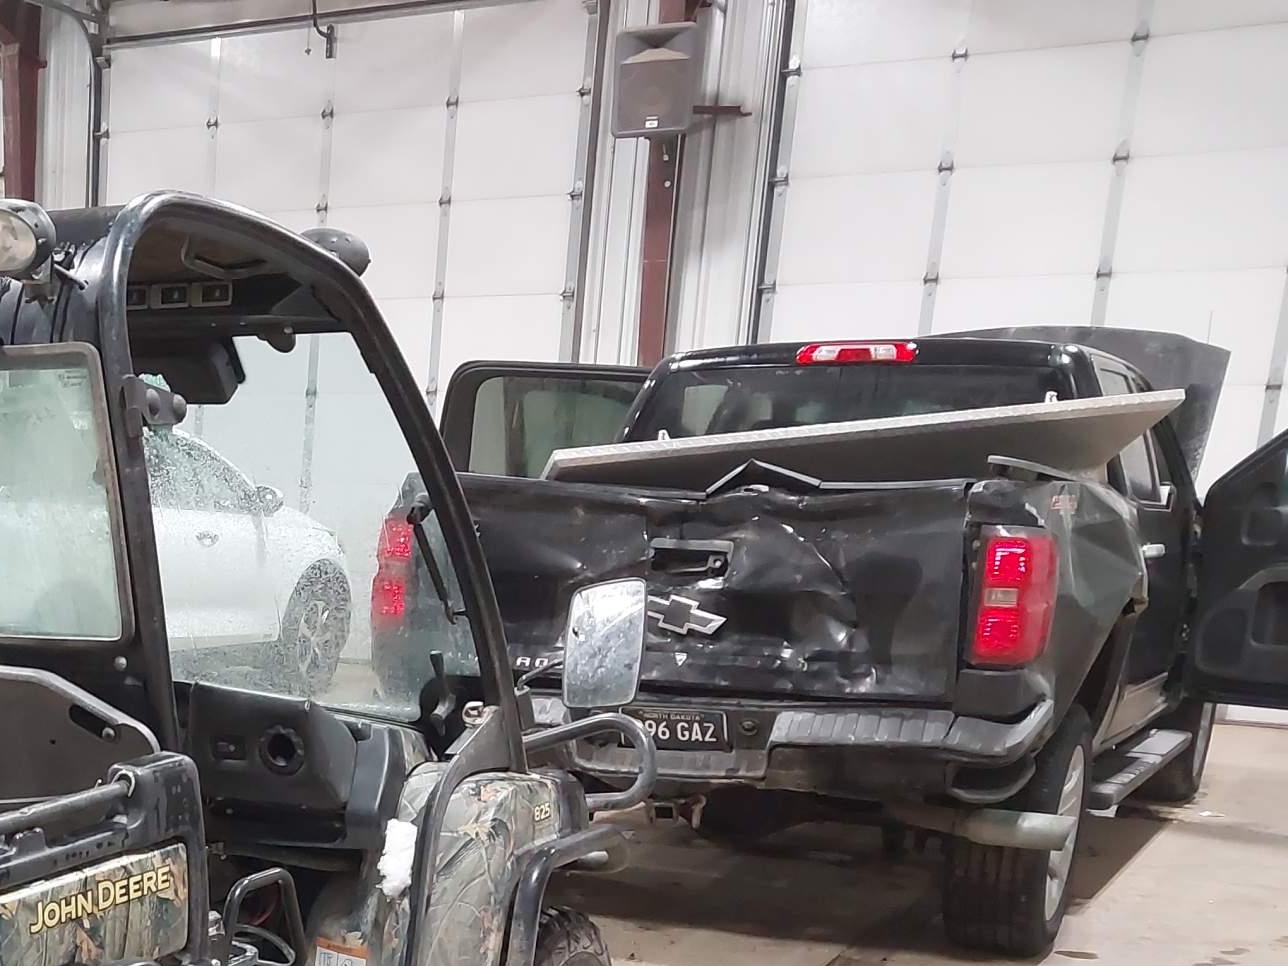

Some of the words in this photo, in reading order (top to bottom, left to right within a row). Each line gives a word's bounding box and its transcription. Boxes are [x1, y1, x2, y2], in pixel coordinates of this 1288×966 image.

[676, 721, 717, 742] GAZ
[533, 801, 552, 822] 825
[29, 890, 93, 934] JOHN
[97, 864, 171, 911] DEERE
